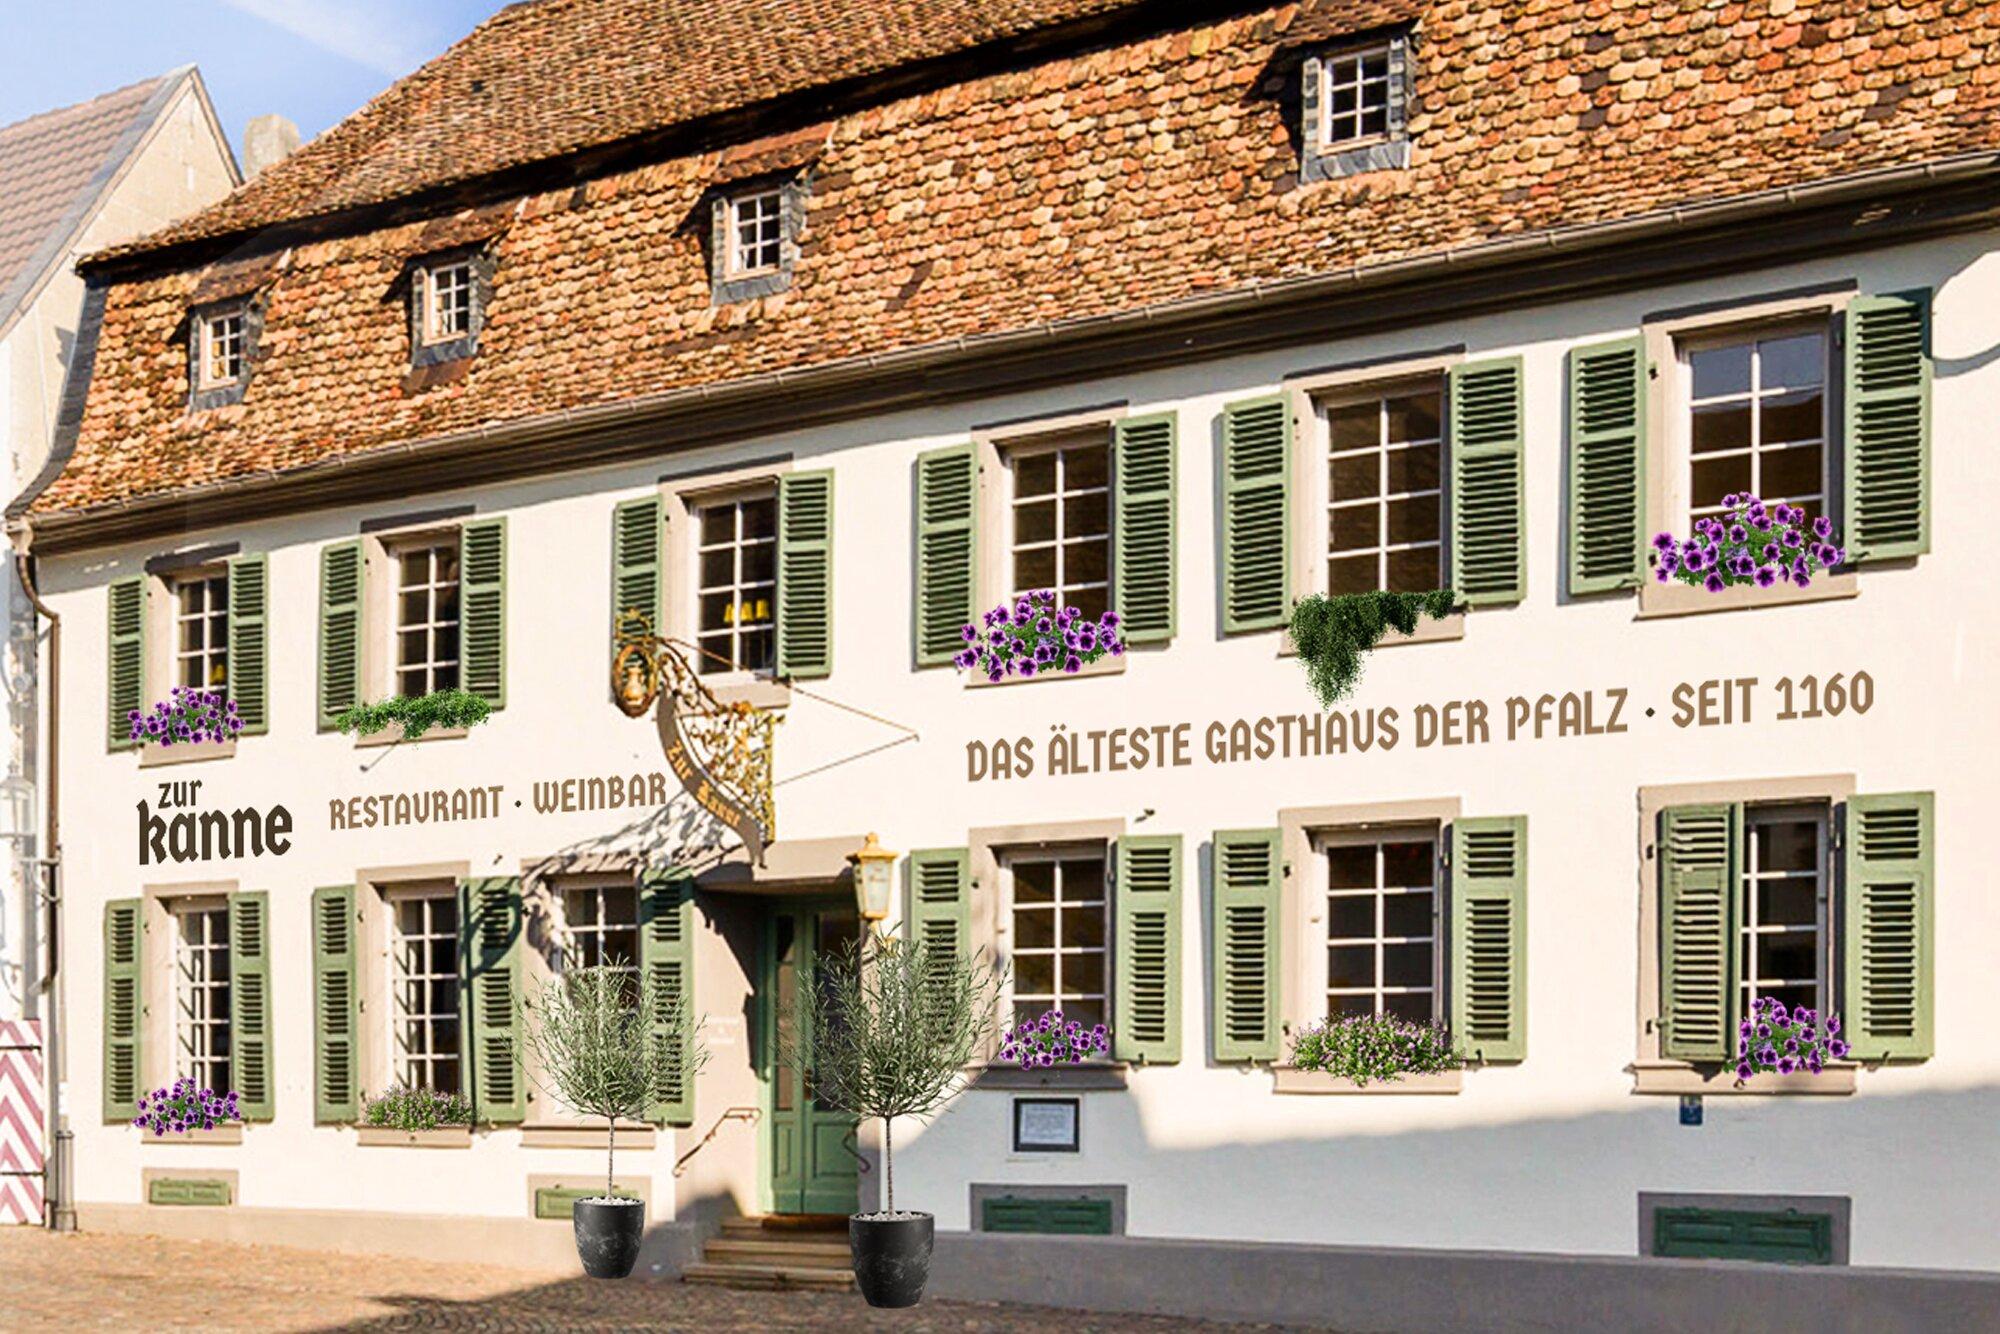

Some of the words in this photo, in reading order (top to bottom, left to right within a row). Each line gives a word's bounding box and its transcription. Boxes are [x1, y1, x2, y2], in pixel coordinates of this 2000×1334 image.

[966, 737, 1034, 783] DAS
[1048, 724, 1192, 777] ÄLTESTE
[1205, 706, 1400, 765] GASTHAUS
[1413, 699, 1490, 748] DER
[1504, 688, 1629, 742] PFALZ
[1672, 677, 1759, 729] SEIT
[1775, 671, 1874, 721] 1160
[158, 778, 203, 810] zur
[329, 786, 504, 832] RESTAURANT
[533, 772, 667, 815] WEINBAR
[136, 799, 293, 866] kanne
